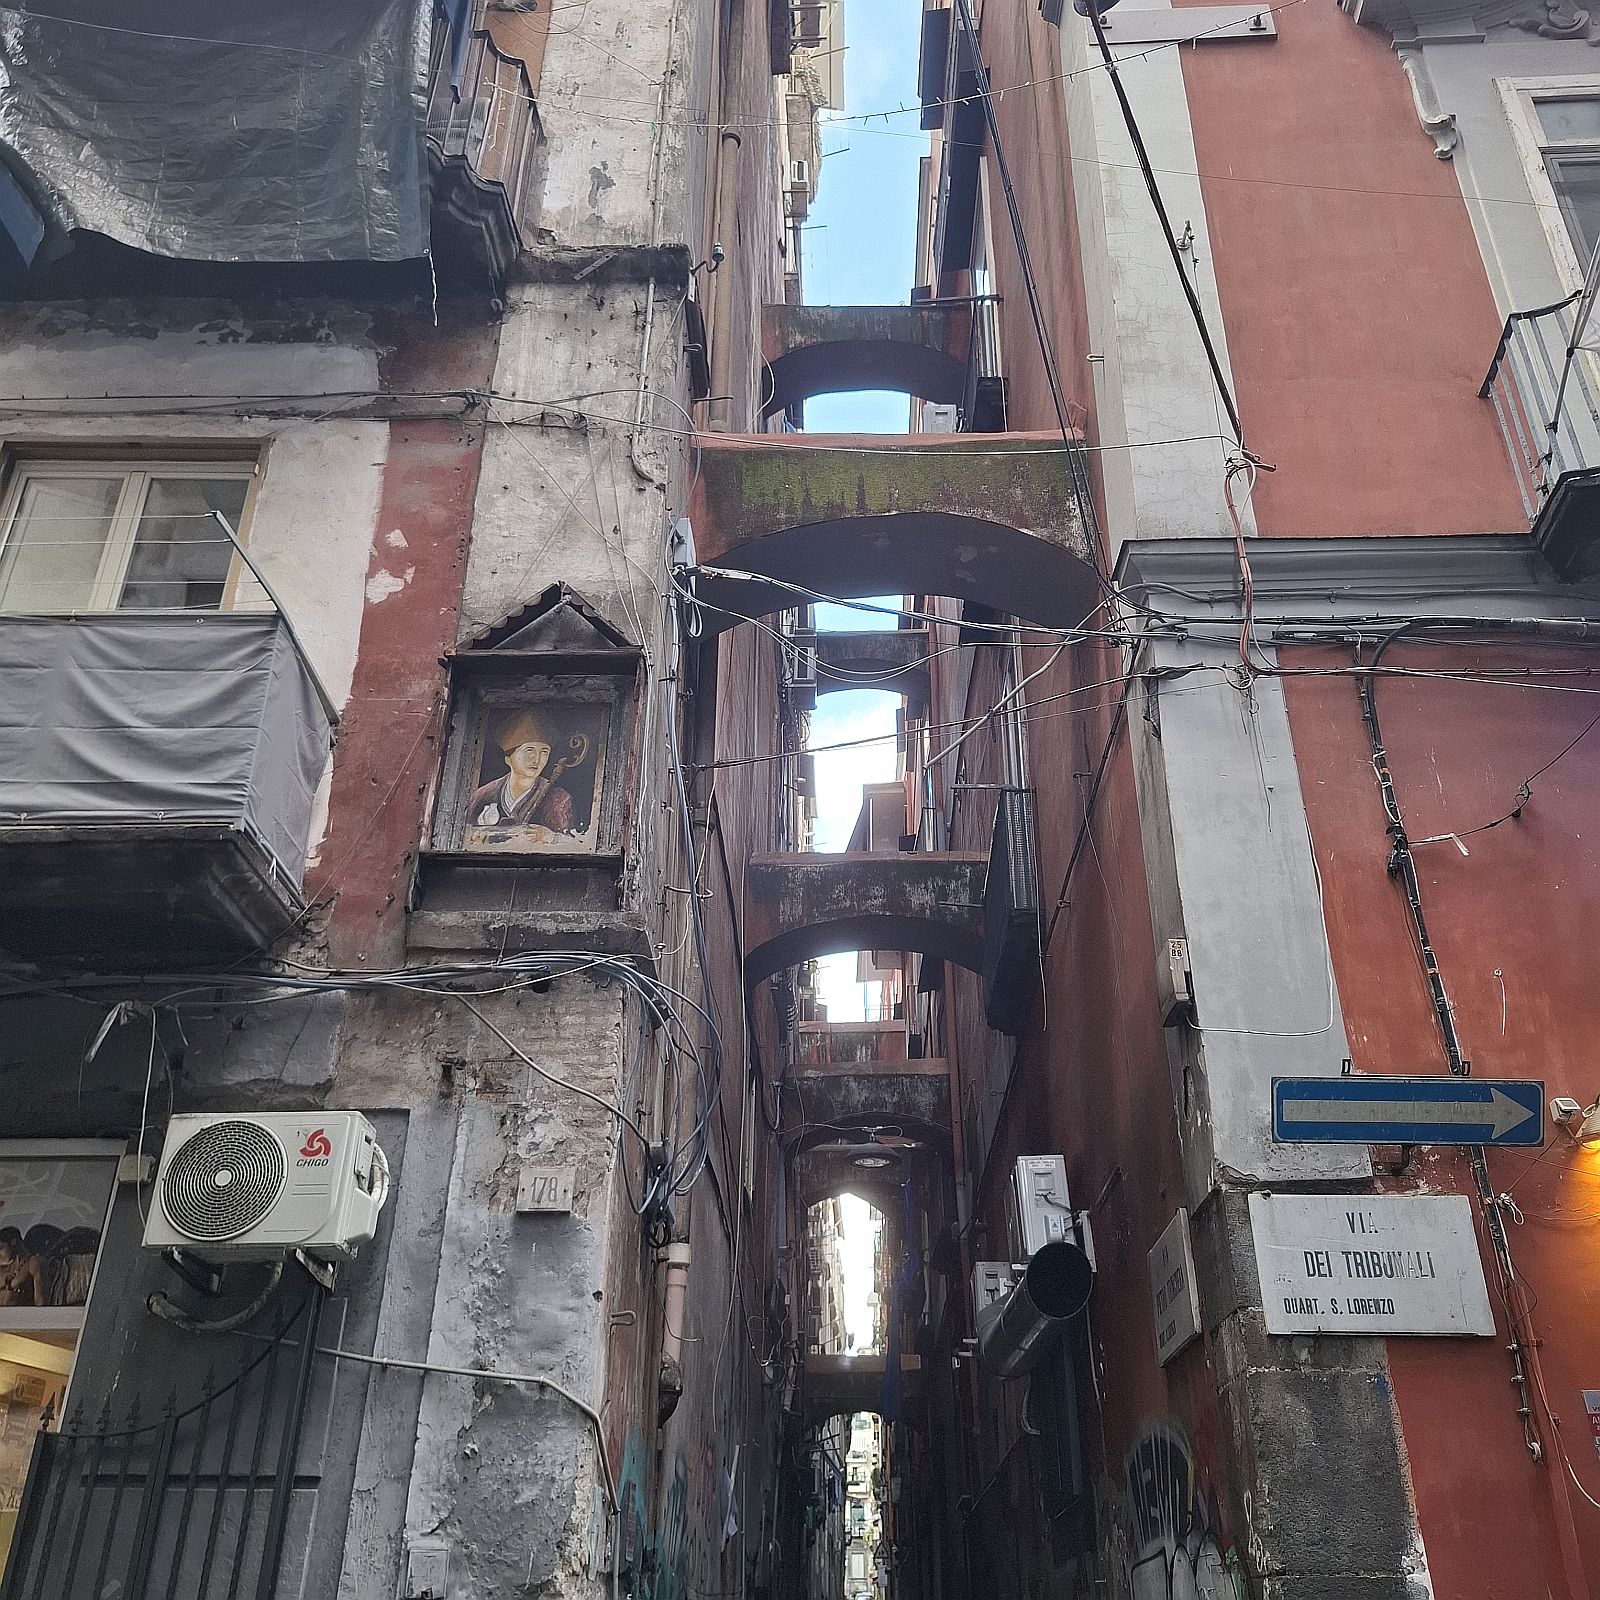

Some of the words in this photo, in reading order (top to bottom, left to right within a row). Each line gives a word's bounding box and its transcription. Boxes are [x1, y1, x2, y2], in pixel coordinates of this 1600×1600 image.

[296, 1158, 329, 1167] CHIGO
[530, 1176, 558, 1203] 178
[1345, 1211, 1379, 1234] VIA
[1303, 1250, 1333, 1278] DEI
[1341, 1250, 1436, 1279] TRIBUNALI
[1283, 1297, 1325, 1315] QUART.
[1330, 1297, 1344, 1315] S.
[1346, 1297, 1395, 1315] LORENZO
